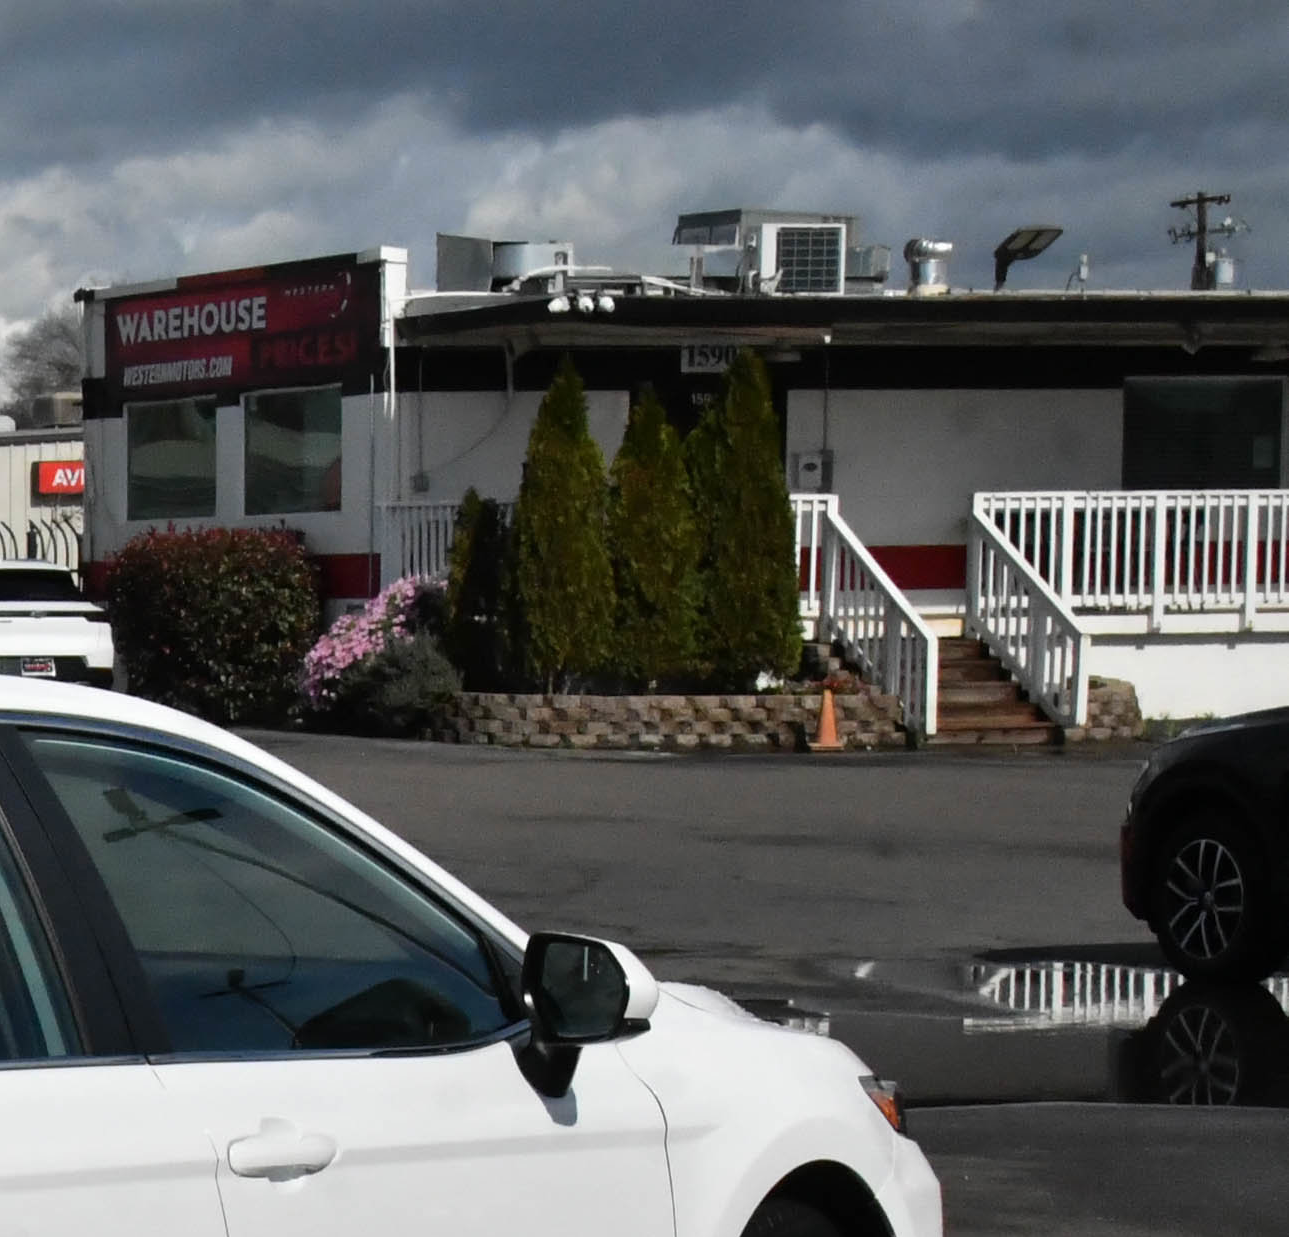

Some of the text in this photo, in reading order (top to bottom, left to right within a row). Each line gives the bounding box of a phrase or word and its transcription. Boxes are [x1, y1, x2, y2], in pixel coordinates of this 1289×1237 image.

[116, 296, 267, 345] WAREHOUSE
[123, 355, 233, 387] WESTERNMOTORS.COM
[52, 468, 85, 487] AVI
